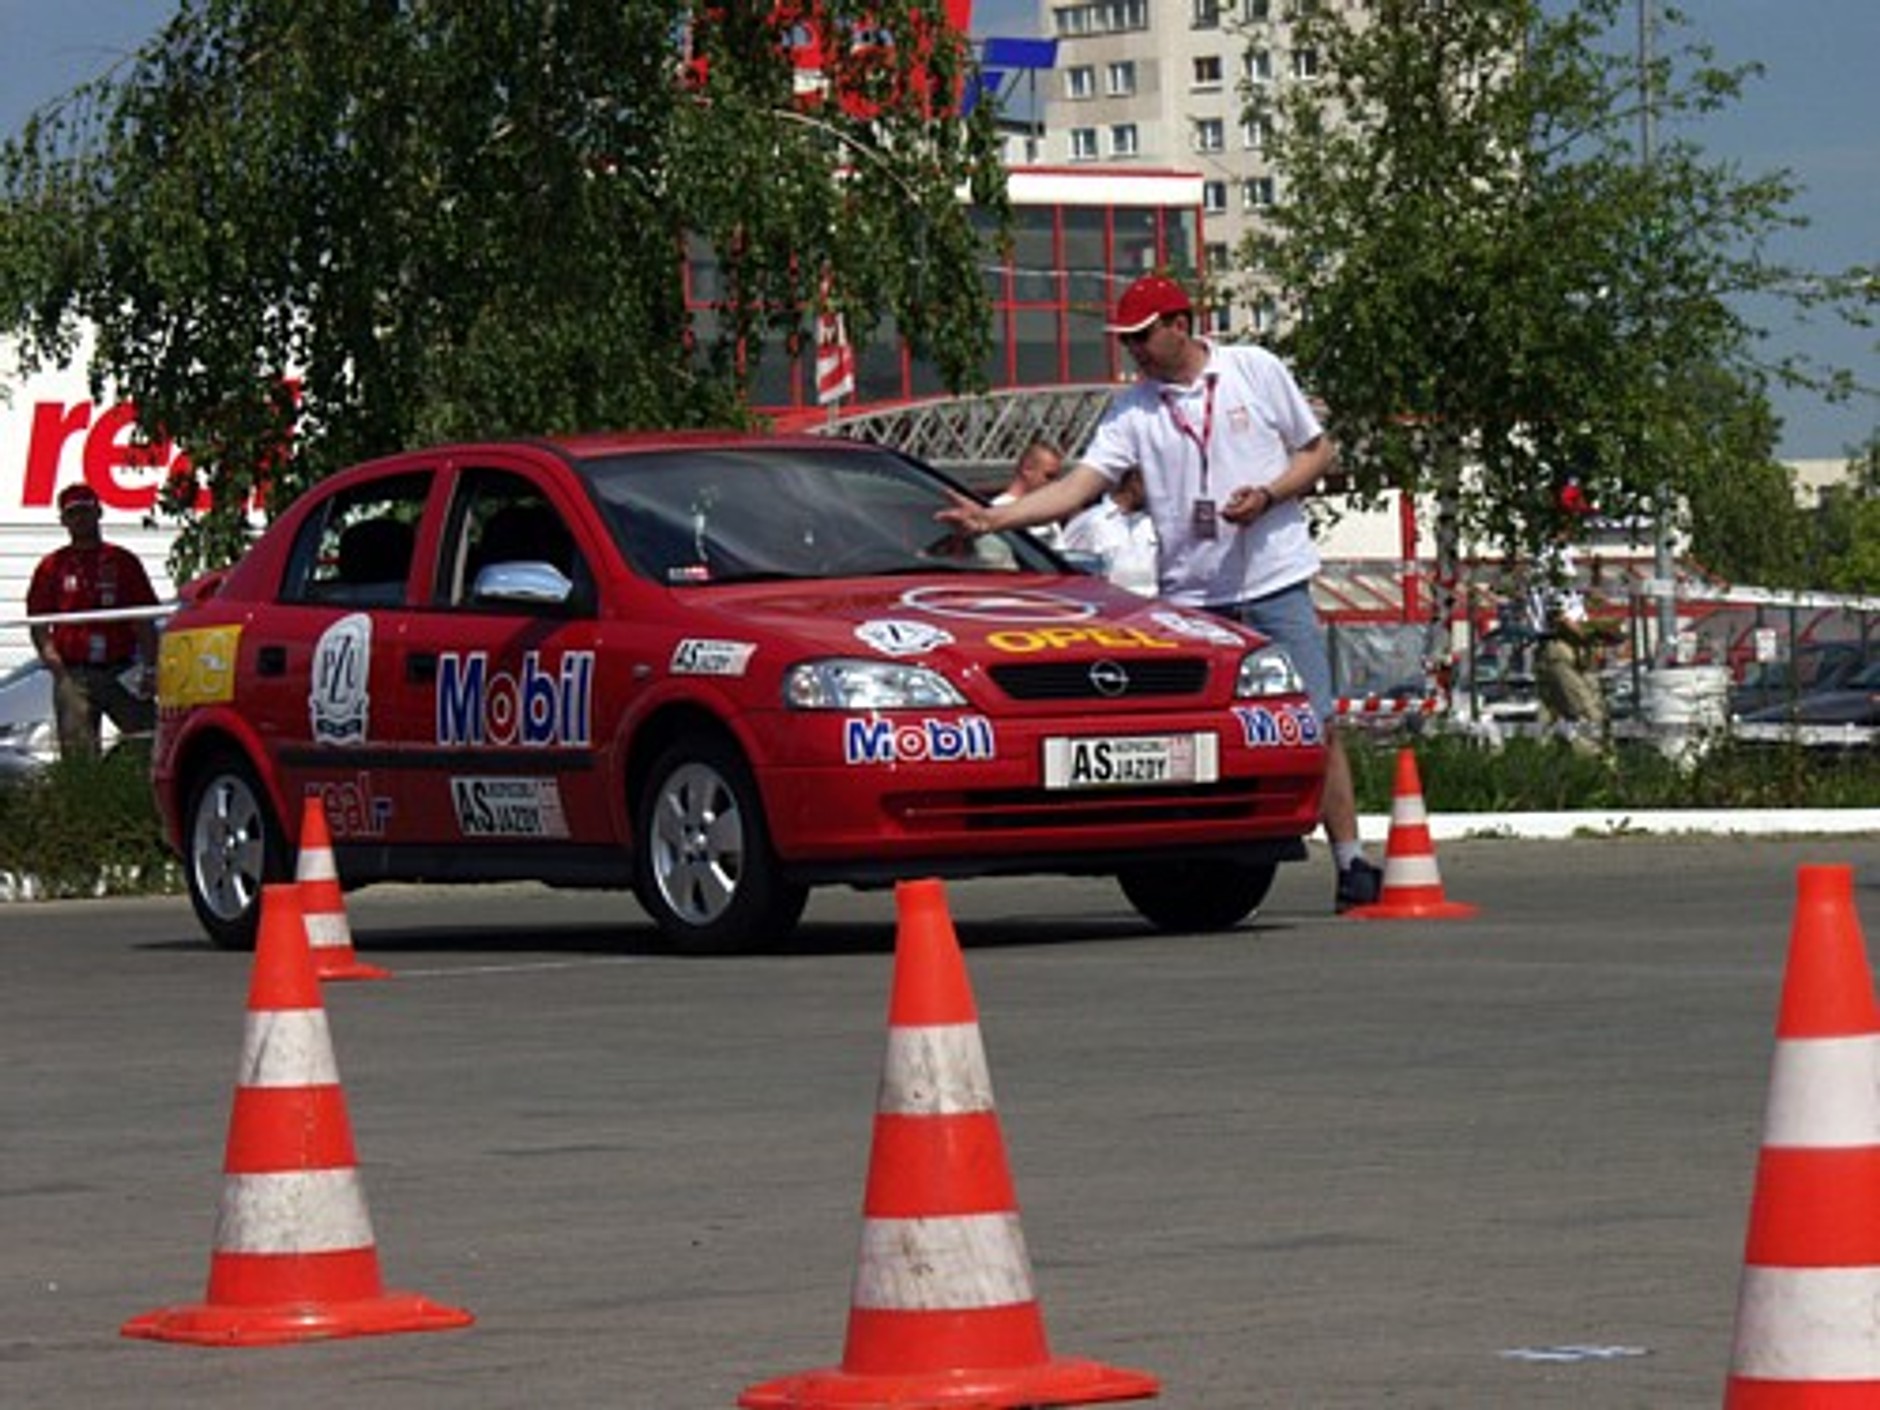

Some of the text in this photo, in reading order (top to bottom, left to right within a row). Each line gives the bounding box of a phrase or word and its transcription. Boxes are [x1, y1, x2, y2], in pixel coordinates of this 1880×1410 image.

[22, 378, 303, 512] re
[986, 626, 1179, 653] OPEL
[437, 651, 594, 746] Mobil
[846, 717, 995, 764] Mobil
[1072, 742, 1112, 780] AS
[457, 781, 495, 832] AS
